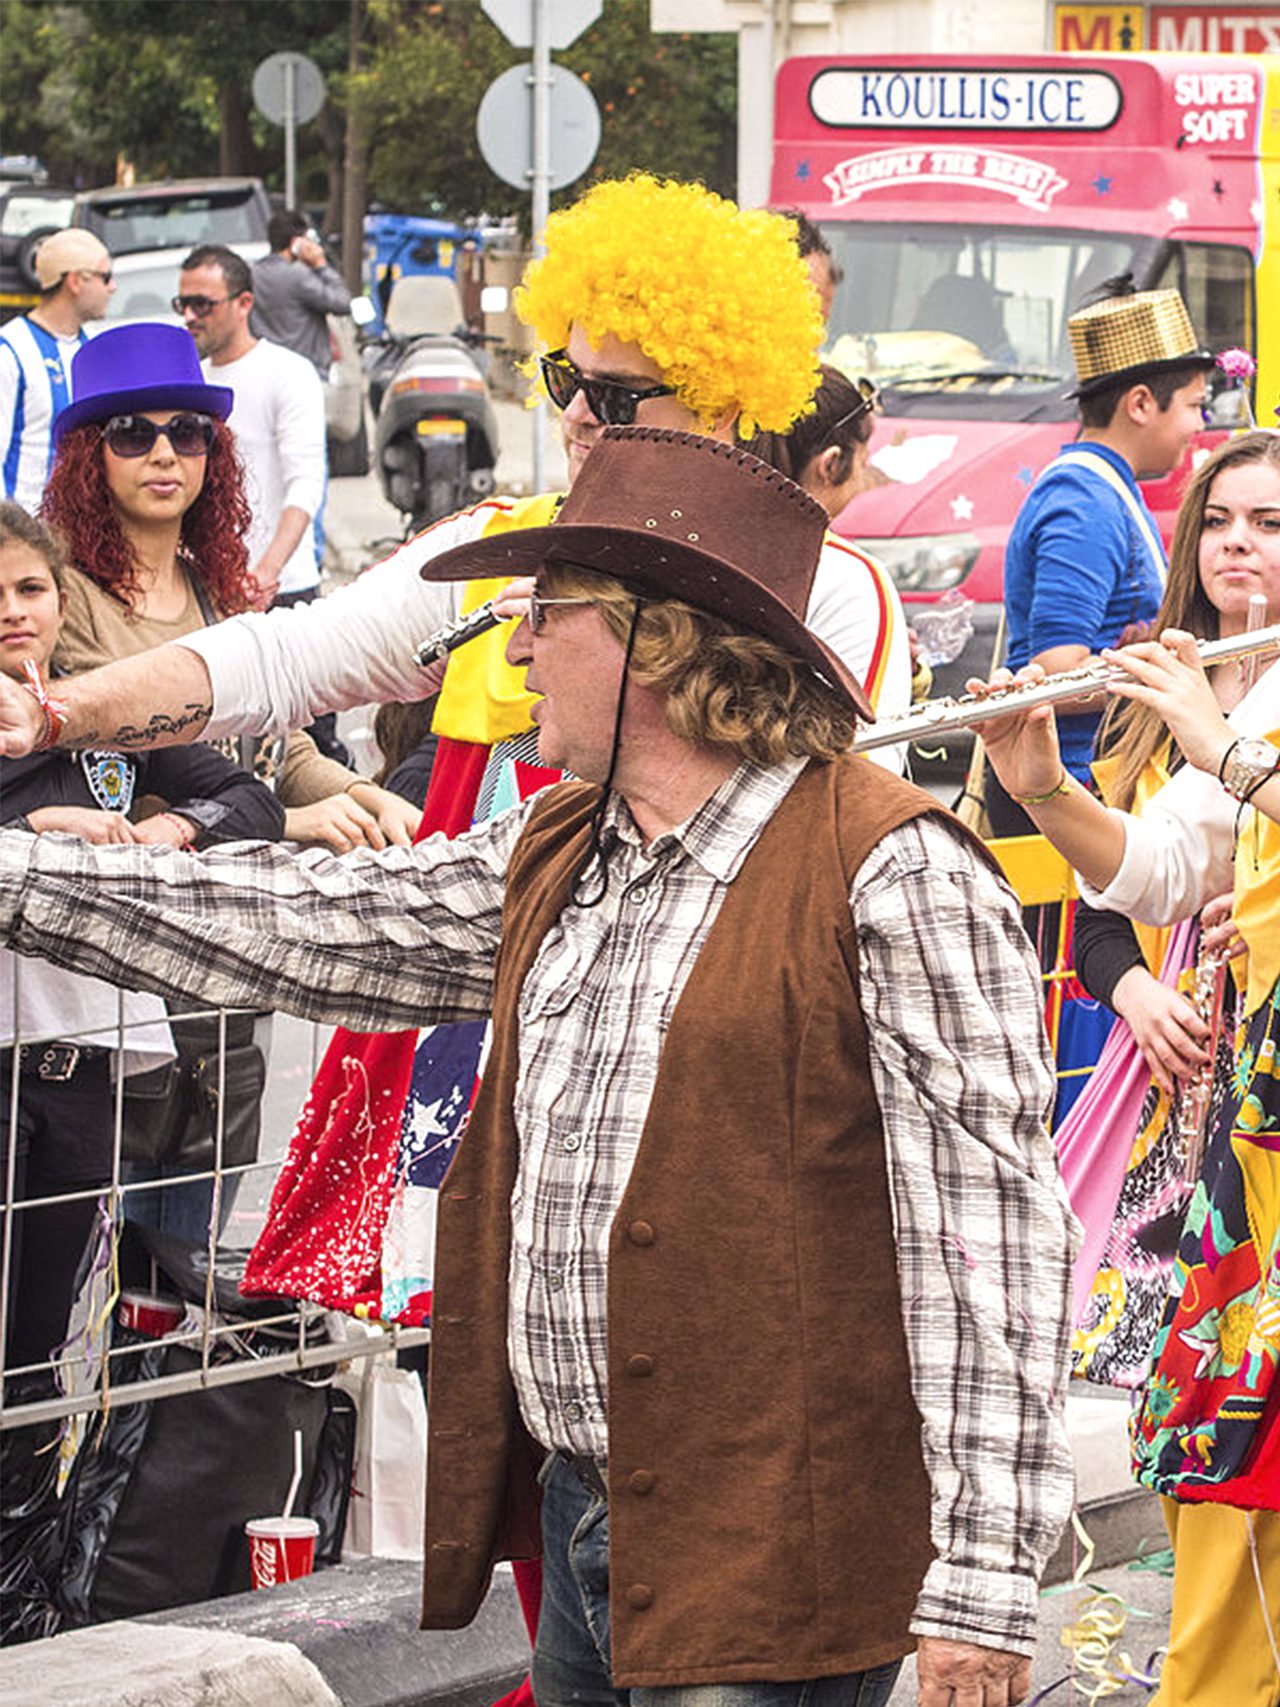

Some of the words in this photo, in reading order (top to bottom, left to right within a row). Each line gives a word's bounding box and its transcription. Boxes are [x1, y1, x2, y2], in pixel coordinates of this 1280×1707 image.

[860, 74, 1086, 122] KOULLIS-ICE
[1174, 74, 1256, 105] SUPER
[1183, 109, 1248, 143] SOFT
[848, 153, 926, 184] SIMPLY
[929, 152, 978, 175] THE
[982, 156, 1043, 189] BEST
